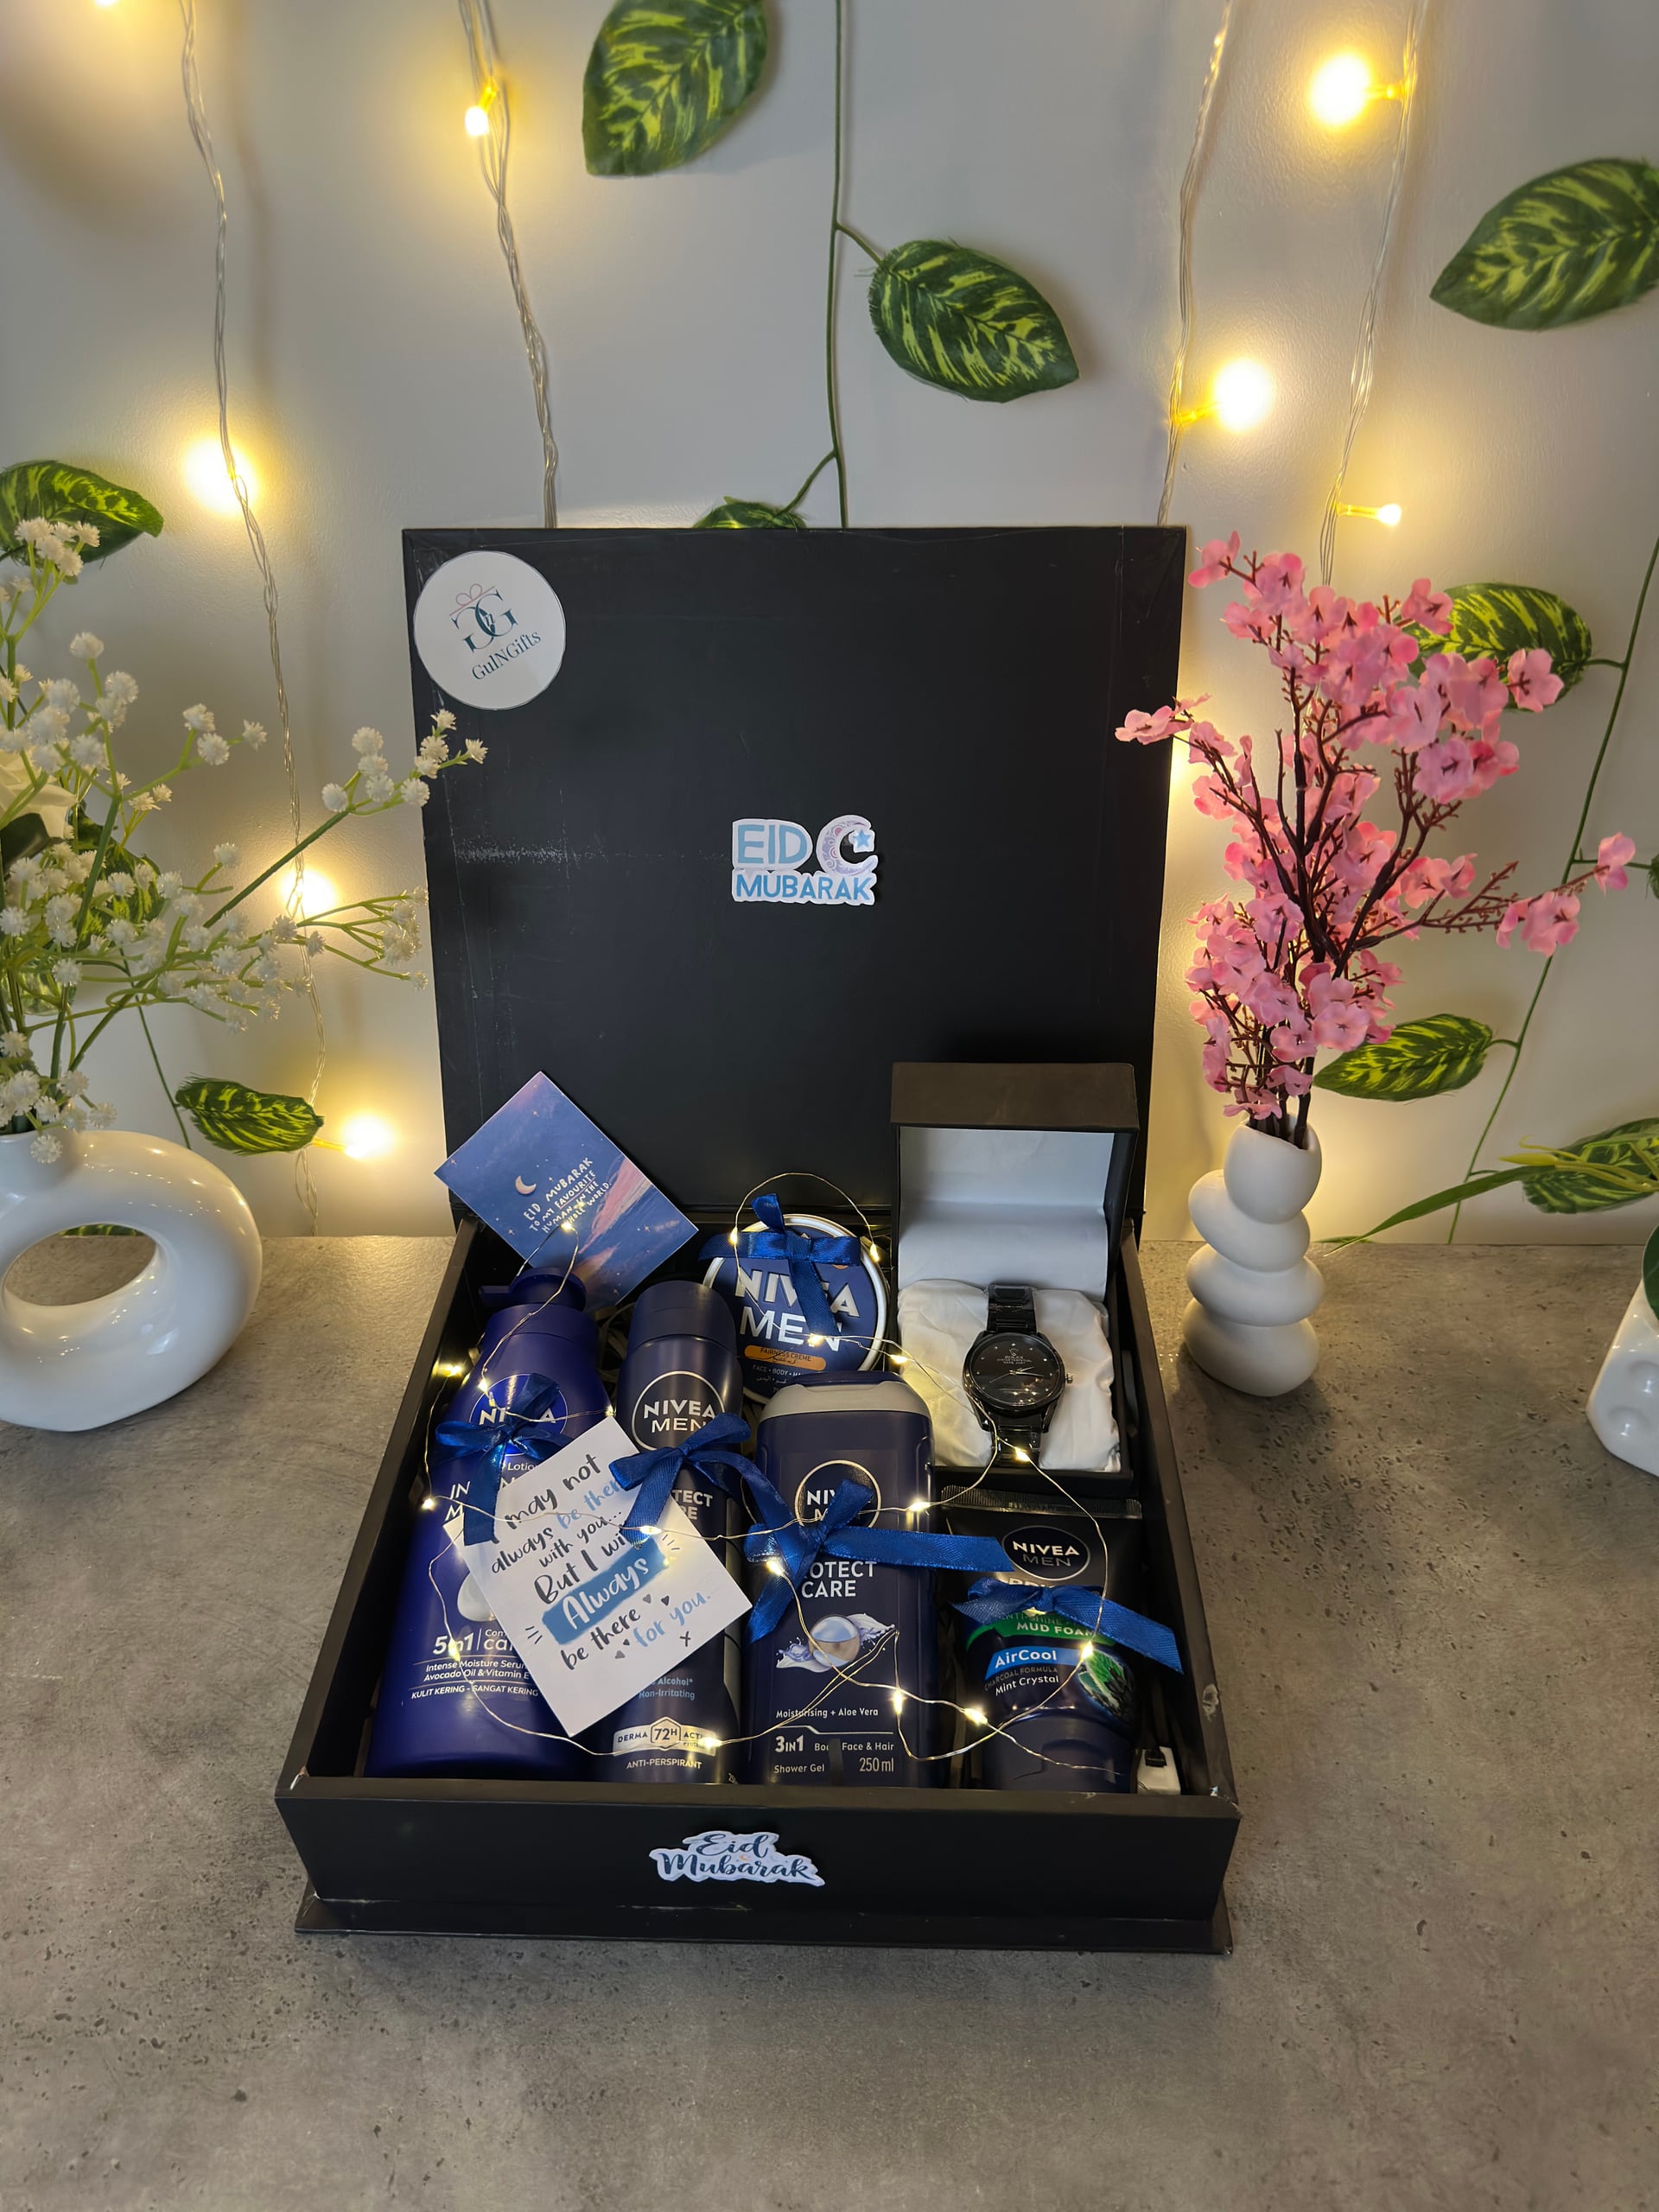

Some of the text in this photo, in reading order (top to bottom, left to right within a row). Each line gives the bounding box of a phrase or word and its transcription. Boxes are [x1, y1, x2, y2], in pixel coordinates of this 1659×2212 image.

[471, 630, 542, 680] GulNGifts
[738, 824, 808, 865] EID
[736, 874, 873, 900] MUBARAK
[524, 1157, 594, 1221] EID MUBARAK
[529, 1170, 596, 1231] TO MY FAVOURITE
[541, 1205, 573, 1233] HUMAN
[585, 1180, 600, 1194] THE
[735, 1265, 860, 1318] NIVA
[760, 1348, 790, 1358] FAIRNESS
[790, 1352, 811, 1362] CREME
[753, 1364, 768, 1373] FACE
[480, 1408, 556, 1426] NIA
[643, 1399, 716, 1420] NIVEA
[505, 1489, 558, 1529] may
[563, 1453, 601, 1491] not
[492, 1527, 555, 1574] always
[556, 1508, 582, 1529] be
[1013, 1541, 1080, 1556] NIVEA
[539, 1539, 574, 1567] with
[1023, 1554, 1071, 1567] MEN
[534, 1562, 580, 1605] But
[580, 1549, 599, 1572] I
[804, 1560, 877, 1578] OTECT
[563, 1558, 649, 1630] Always
[801, 1580, 856, 1598] CARE
[632, 1621, 665, 1648] for
[1017, 1622, 1050, 1632] MUD
[560, 1609, 641, 1670] be there
[426, 1662, 458, 1673] Intense
[460, 1659, 499, 1668] Moisture
[995, 1649, 1057, 1669] AirCool
[423, 1670, 461, 1682] Avocado
[463, 1669, 476, 1677] Oil
[477, 1669, 484, 1677] &
[486, 1669, 522, 1679] Vitamin
[984, 1666, 1058, 1691] CHARCOAL FORMULA
[995, 1675, 1059, 1696] Mint Crystal
[411, 1688, 433, 1700] KULIT
[434, 1685, 465, 1695] KERING
[472, 1685, 506, 1694] SANGAT
[507, 1686, 539, 1697] KERING
[639, 1689, 696, 1700] Non-Irritating
[838, 1707, 857, 1717] Aloe
[859, 1707, 879, 1716] Vera
[618, 1731, 648, 1743] DERMA
[654, 1728, 677, 1741] 72H
[842, 1742, 863, 1751] Face
[866, 1742, 873, 1751] &
[874, 1742, 895, 1751] Hair
[626, 1758, 702, 1770] ANTI-PERSPIRANT
[774, 1764, 825, 1774] Shower Gel
[859, 1757, 894, 1772] 250 ml
[696, 1834, 769, 1858] Eid
[658, 1853, 817, 1881] Mubarak
